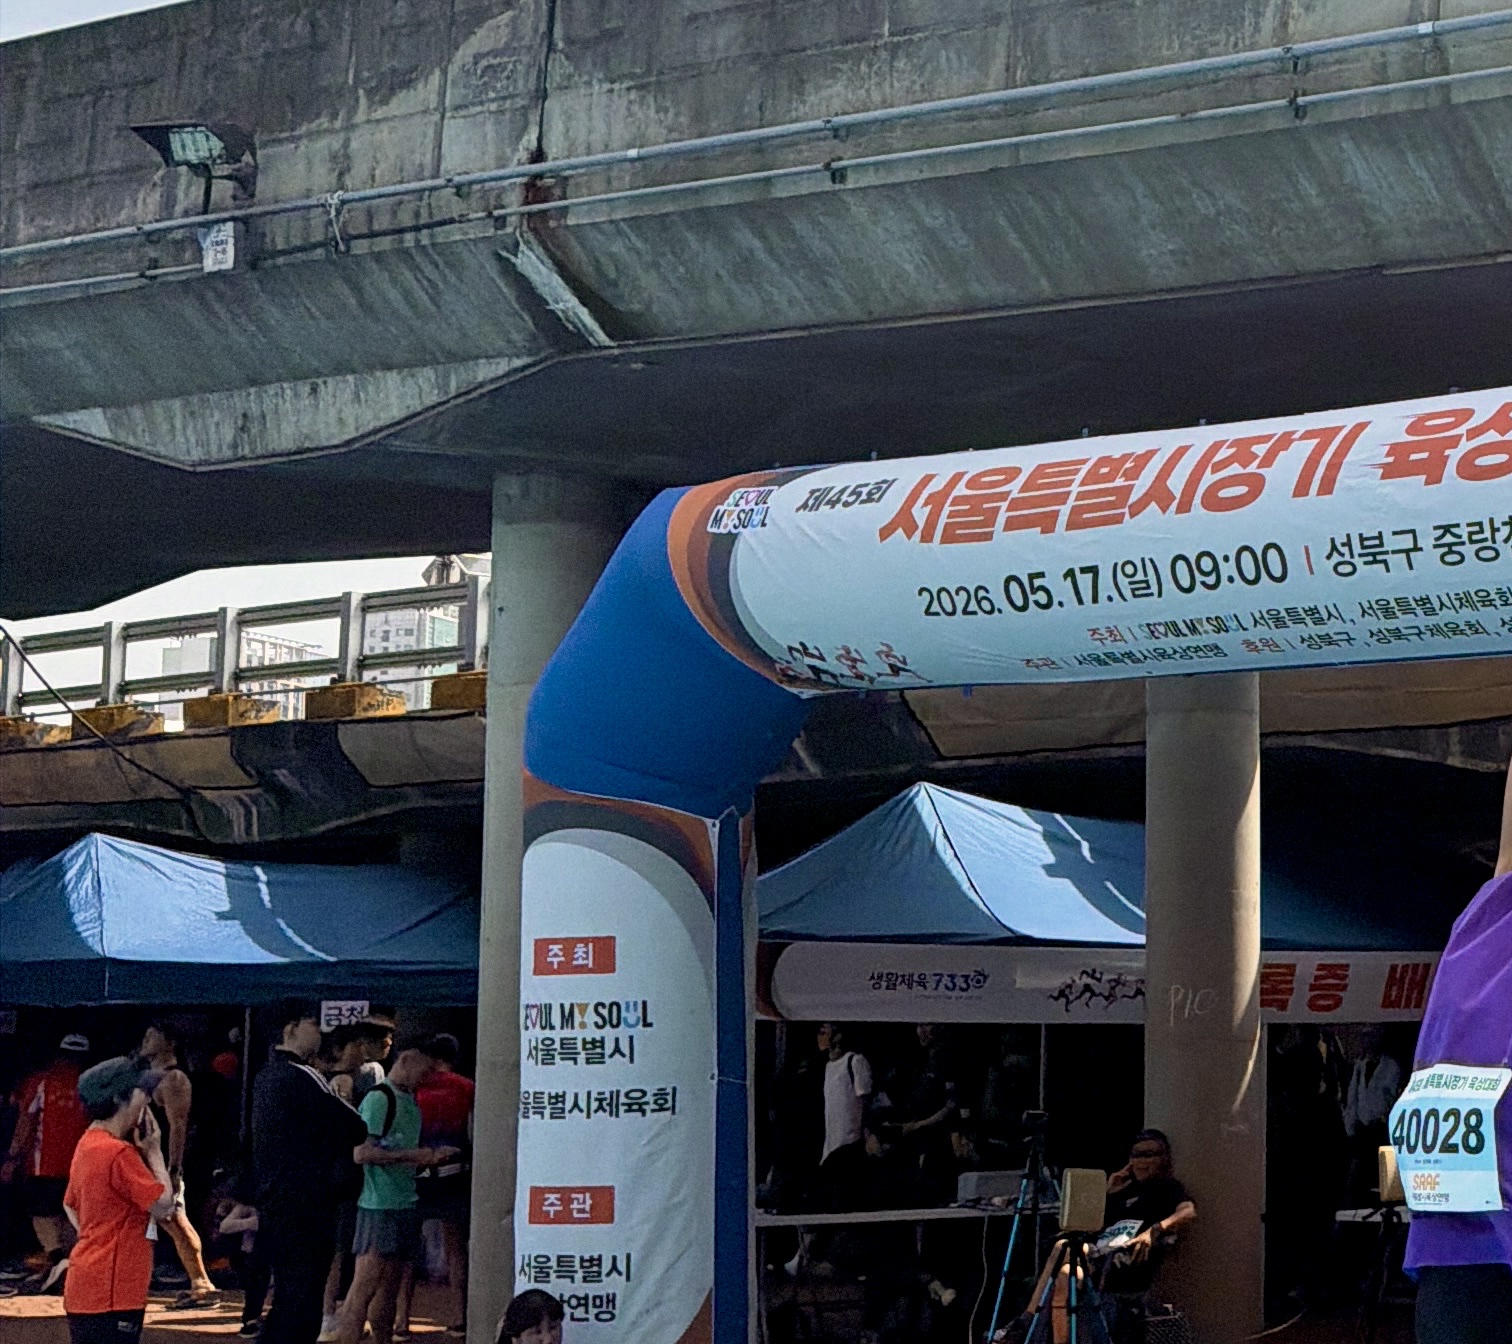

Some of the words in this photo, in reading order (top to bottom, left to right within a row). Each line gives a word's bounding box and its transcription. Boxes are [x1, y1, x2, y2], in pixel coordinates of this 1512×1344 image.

[795, 478, 899, 512] 제45회
[879, 421, 1372, 544] 서울특별시장기
[1170, 543, 1288, 594] 09:00
[1325, 529, 1423, 578] 성북구
[1087, 625, 1128, 646] 주최
[1022, 656, 1062, 671] 주관
[1073, 642, 1229, 667] 서울특별시육상연맹
[1240, 637, 1285, 654] 후원
[546, 942, 594, 970] 주최
[1260, 963, 1350, 1013] 록증
[523, 1002, 556, 1031] EOUL
[526, 1034, 635, 1067] 서울특별시
[520, 1085, 677, 1120] 울특별시체육회
[1392, 1107, 1485, 1155] 40028
[541, 1191, 593, 1220] 주관
[519, 1252, 632, 1284] 서울특별시
[559, 1292, 617, 1323] 연맹
